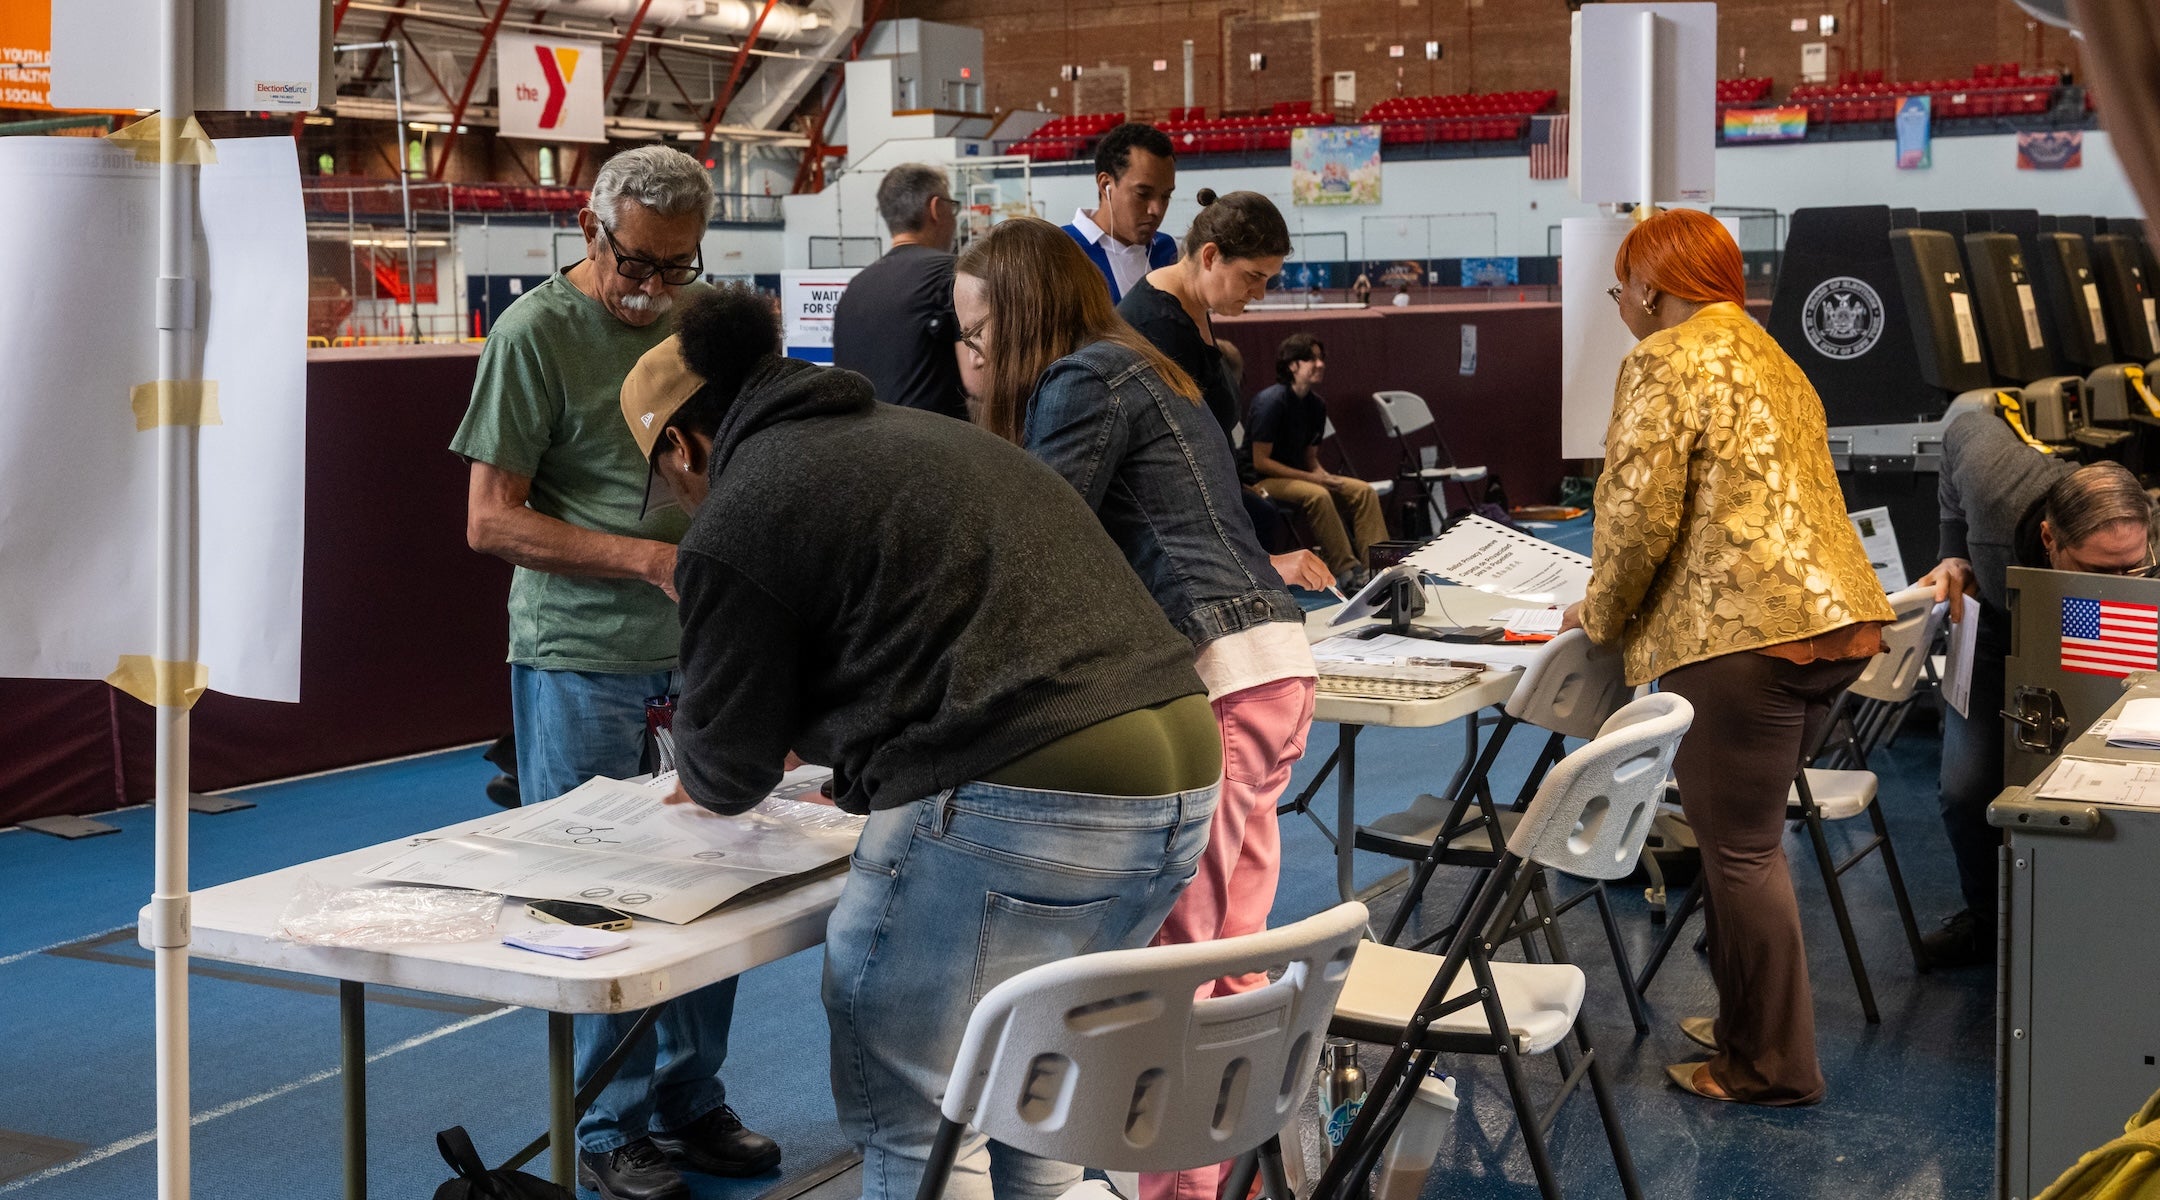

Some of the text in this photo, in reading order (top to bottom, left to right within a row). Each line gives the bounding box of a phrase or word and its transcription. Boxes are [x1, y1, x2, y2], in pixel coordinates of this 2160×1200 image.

[3, 47, 43, 63] YOUTH
[5, 88, 45, 104] SOCIAL
[516, 84, 538, 102] the
[811, 290, 839, 301] WAIT
[803, 303, 824, 313] FOR
